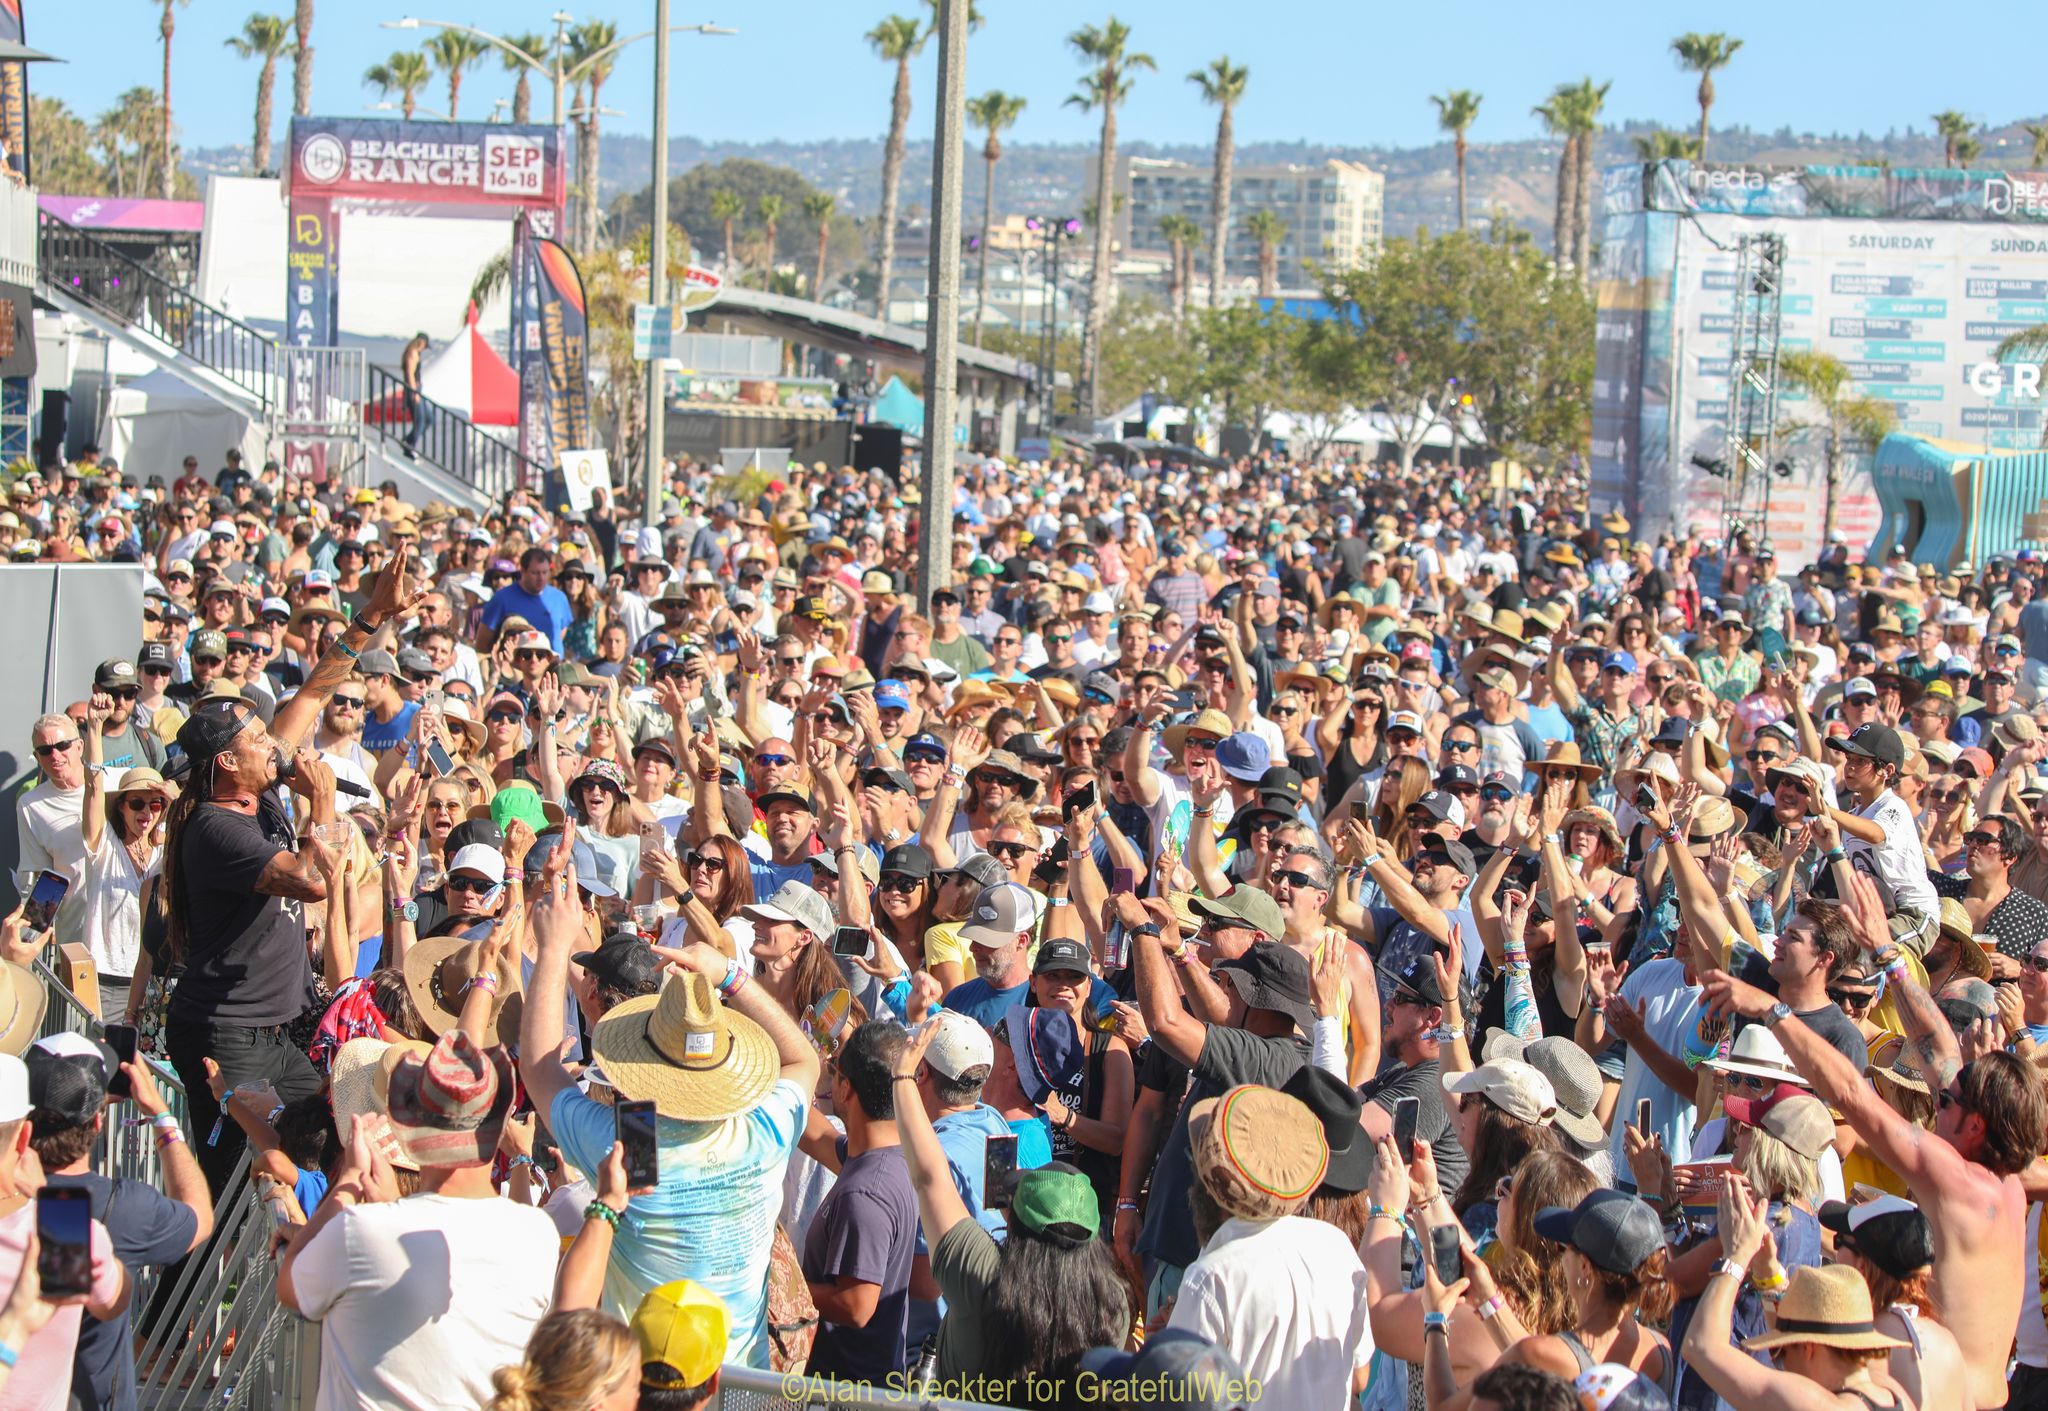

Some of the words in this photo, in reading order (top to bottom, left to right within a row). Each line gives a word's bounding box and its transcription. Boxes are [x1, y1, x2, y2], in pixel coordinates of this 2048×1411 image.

[350, 140, 480, 161] BEACHLIFE
[490, 145, 541, 168] SEP
[350, 159, 480, 187] RANCH
[489, 171, 538, 188] 16-18
[1848, 235, 1935, 250] SATURDAY
[1991, 239, 2048, 253] SUNDA
[544, 299, 567, 392] CABANA
[566, 335, 588, 449] ENTRANCE
